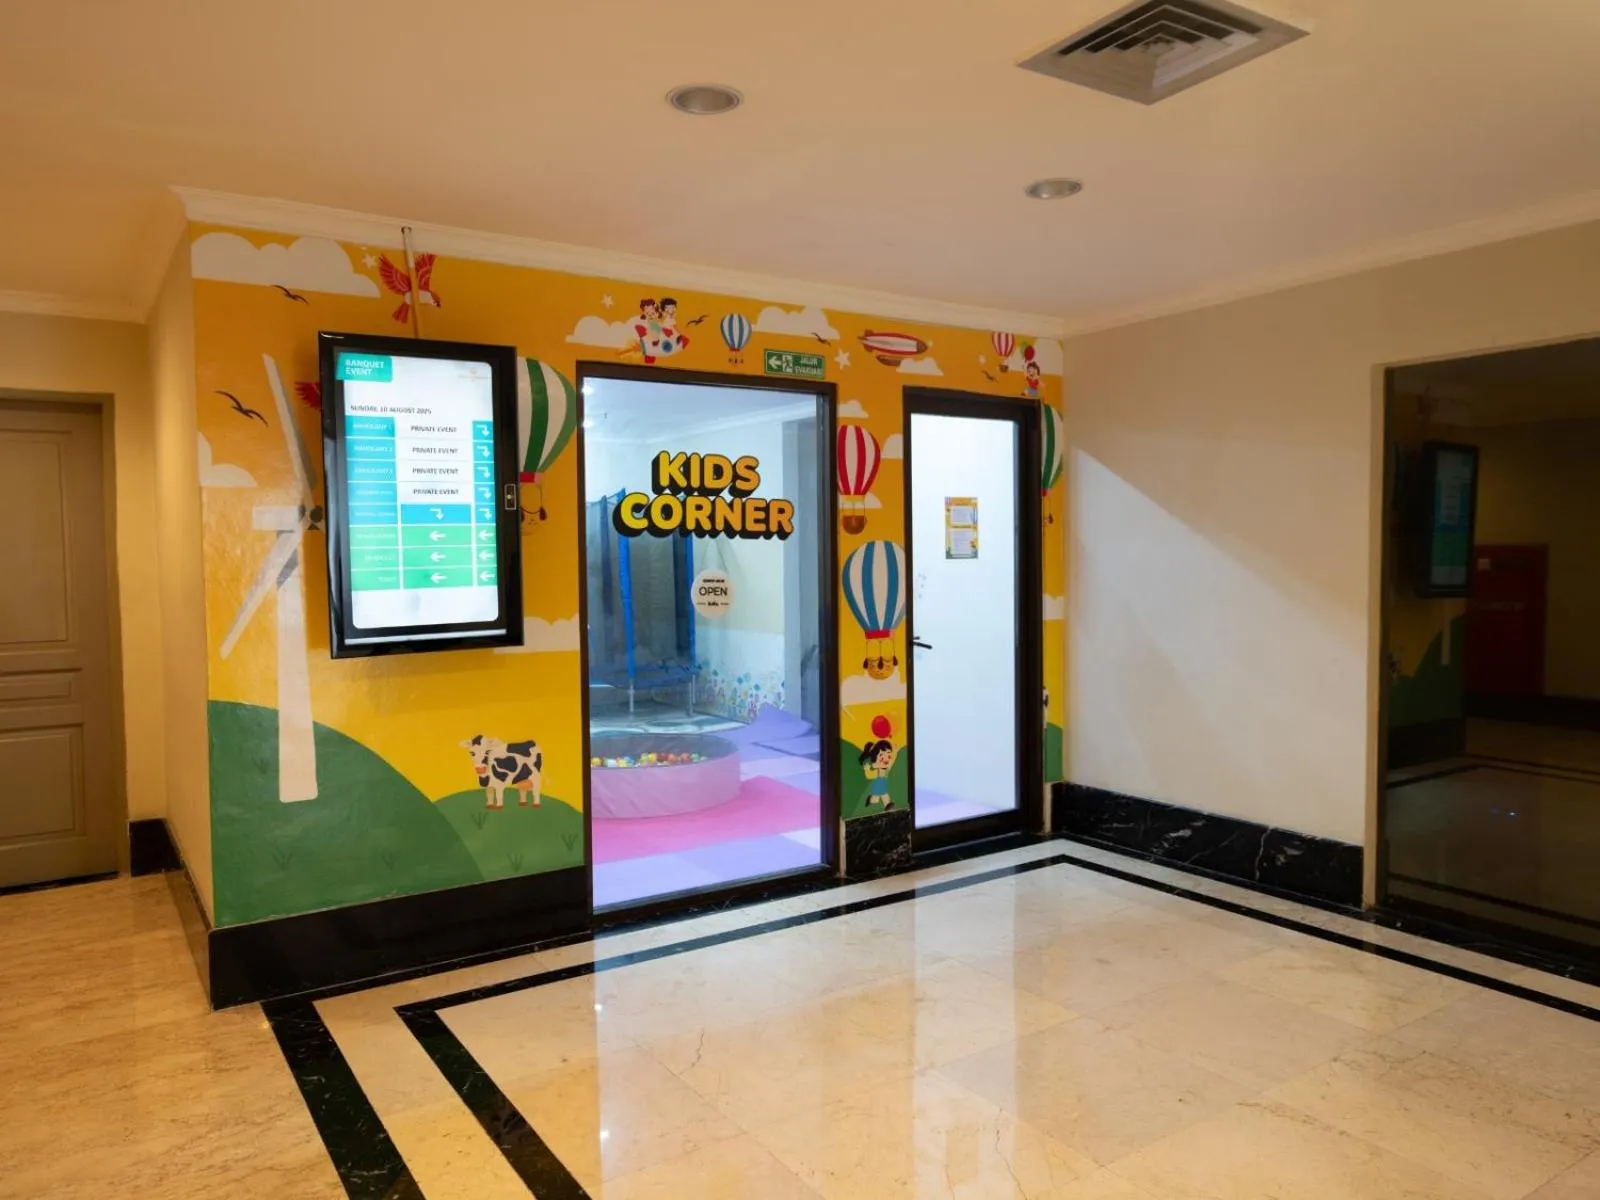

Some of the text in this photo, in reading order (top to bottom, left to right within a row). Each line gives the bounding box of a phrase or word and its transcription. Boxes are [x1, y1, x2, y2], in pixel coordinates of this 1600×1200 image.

[345, 359, 385, 369] BANQUET
[345, 367, 373, 376] EVENT
[389, 406, 415, 414] AUGUST
[438, 467, 459, 475] EVENT
[651, 449, 762, 498] KIDS
[612, 492, 795, 541] CORNER
[698, 586, 728, 597] OPEN
